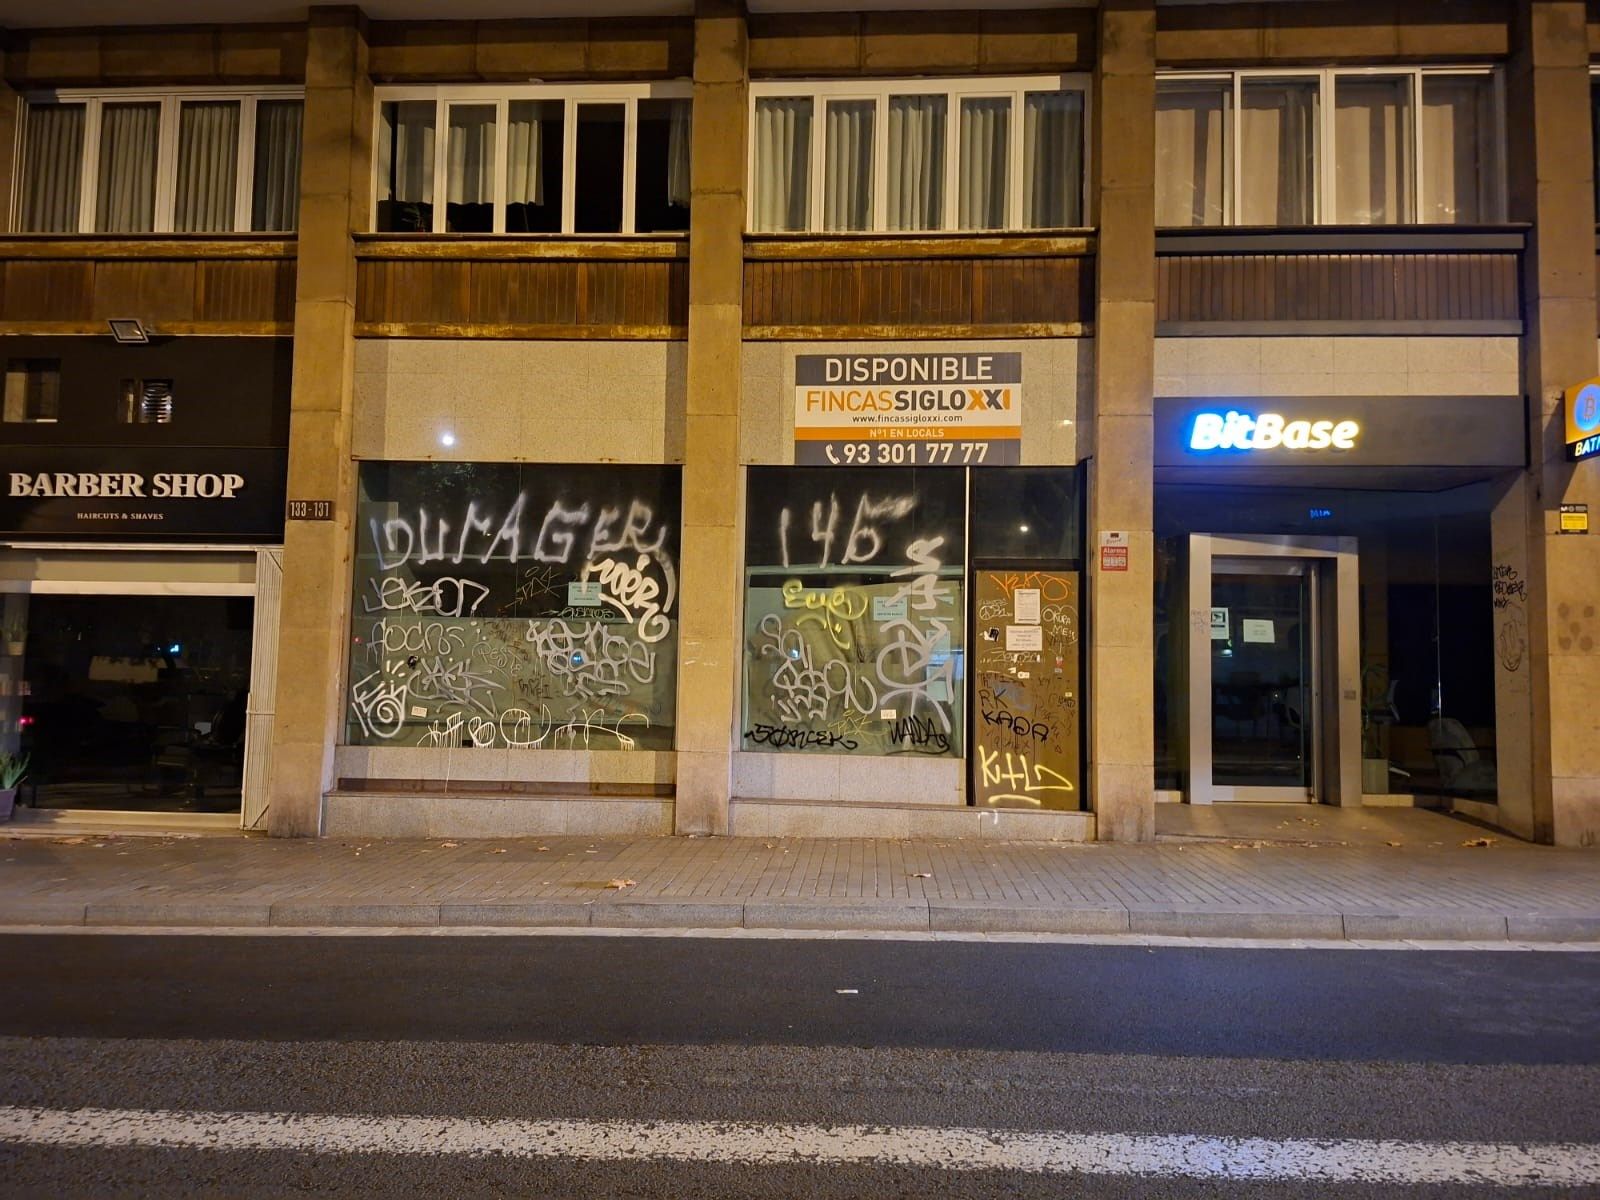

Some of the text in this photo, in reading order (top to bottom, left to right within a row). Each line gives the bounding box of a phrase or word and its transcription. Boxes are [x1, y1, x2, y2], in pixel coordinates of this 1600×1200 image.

[825, 356, 993, 382] DISPONIBLE
[852, 414, 963, 424] www.fincassigloxxi.com
[1190, 410, 1359, 450] BitBase
[890, 429, 904, 437] EN
[906, 428, 944, 437] LOCALS
[843, 442, 989, 464] 93 301 77 77
[8, 472, 244, 498] BARBER SHOP
[77, 512, 164, 520] HAIRCUTS & SHAVES
